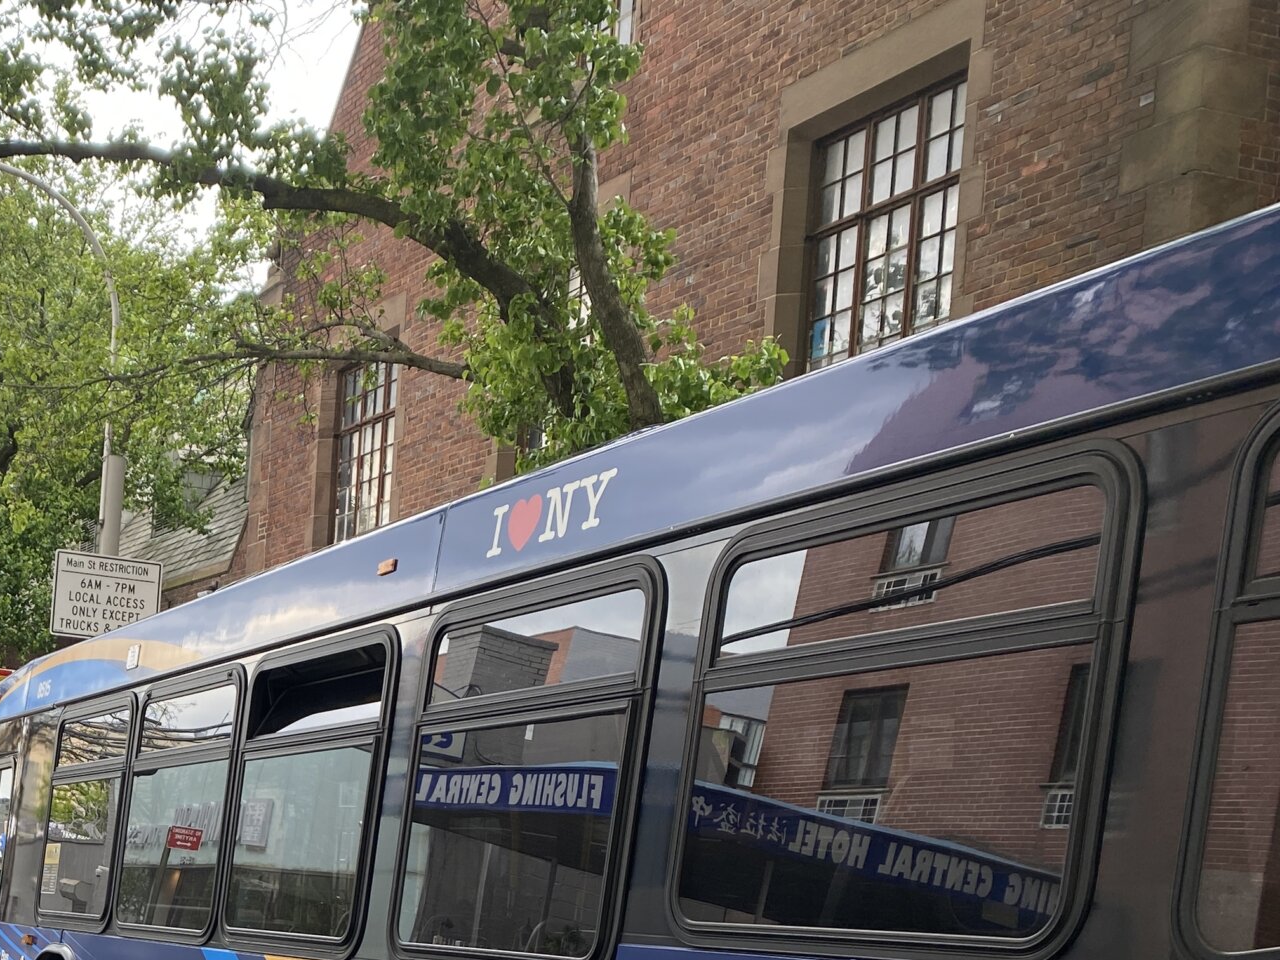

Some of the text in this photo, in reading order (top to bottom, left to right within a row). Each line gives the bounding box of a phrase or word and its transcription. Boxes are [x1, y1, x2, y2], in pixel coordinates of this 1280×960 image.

[66, 557, 149, 576] Main St RESTRICTION
[80, 578, 102, 590] 6AM
[114, 582, 136, 594] 7PM
[68, 591, 145, 609] LOCAL ACCESS
[72, 605, 140, 622] ONLY EXCEPT
[60, 618, 99, 632] TRUCKS
[104, 623, 111, 633] &
